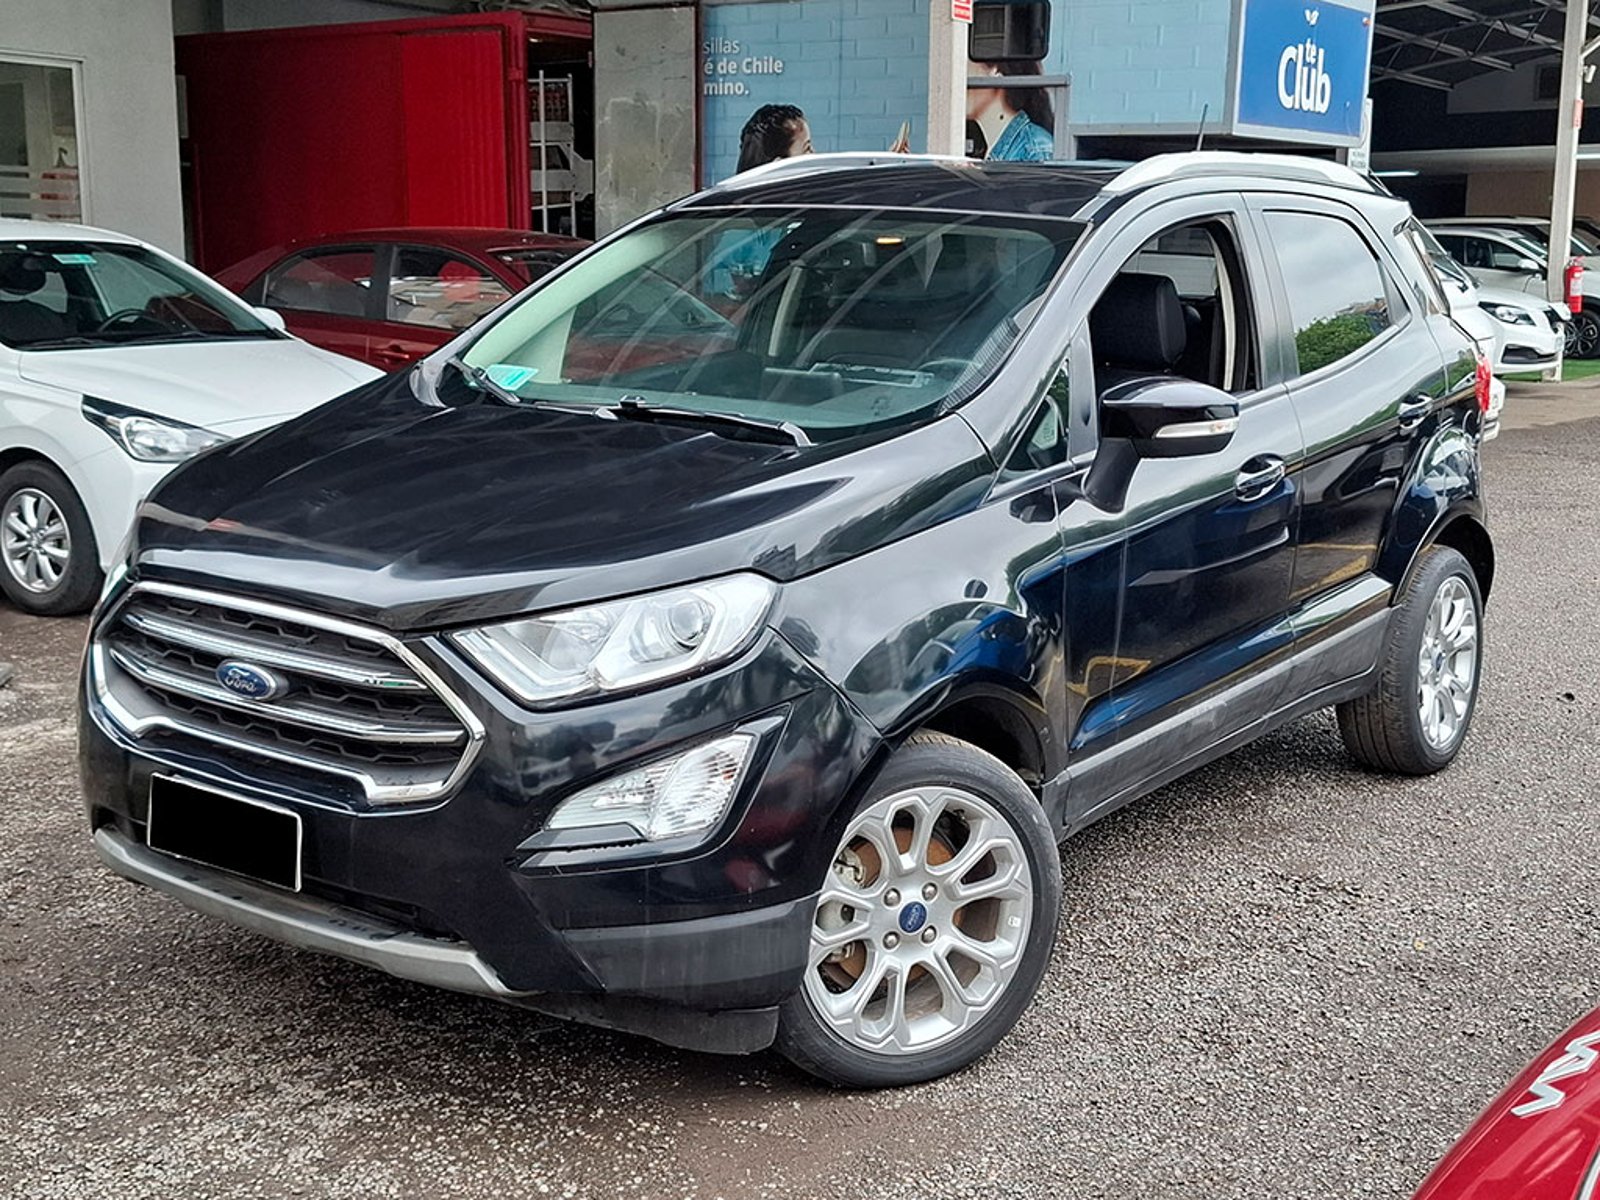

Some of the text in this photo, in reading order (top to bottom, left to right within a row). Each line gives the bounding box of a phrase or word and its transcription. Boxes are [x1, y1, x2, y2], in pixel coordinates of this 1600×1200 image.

[703, 37, 740, 54] sillas
[704, 55, 784, 75] é de Chile
[704, 78, 750, 95] mino.
[1277, 43, 1331, 114] Club
